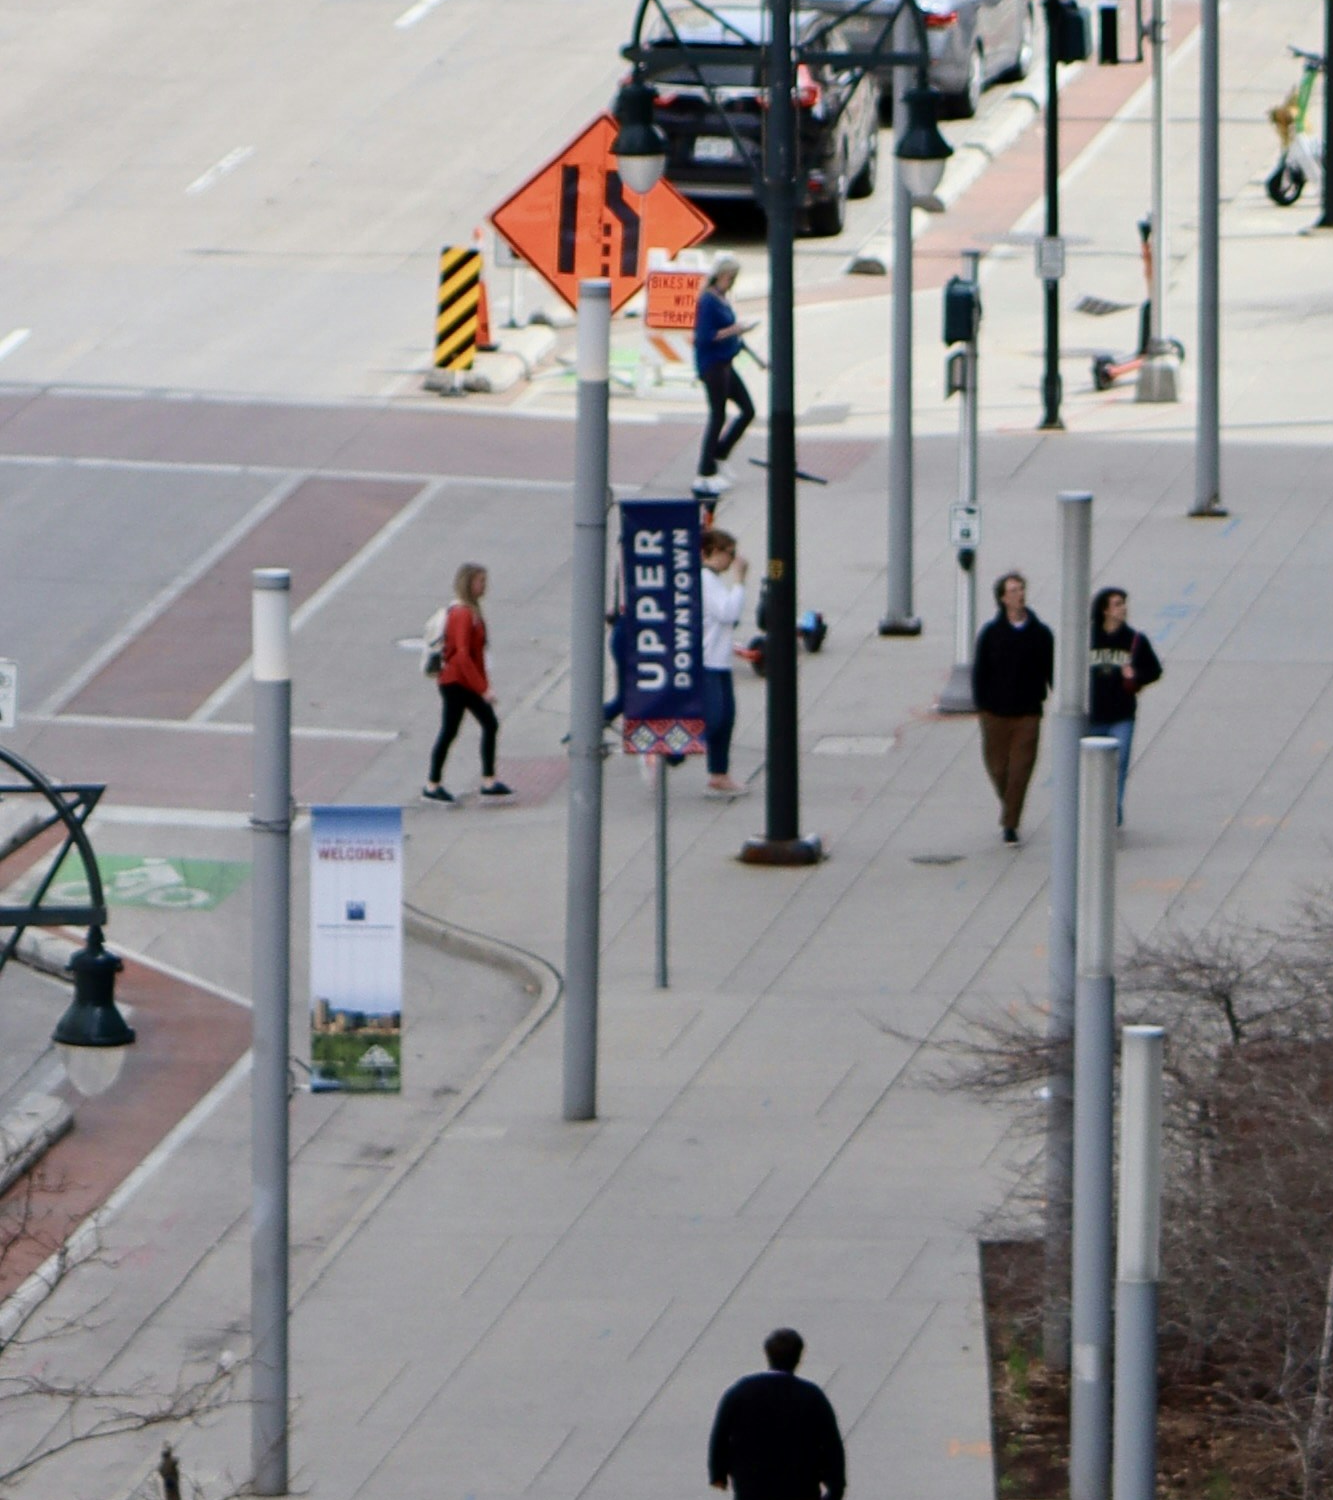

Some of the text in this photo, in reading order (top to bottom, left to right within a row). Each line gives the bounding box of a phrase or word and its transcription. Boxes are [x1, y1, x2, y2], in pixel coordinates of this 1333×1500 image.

[652, 276, 684, 289] BIKES
[634, 530, 667, 690] UPPER
[673, 529, 692, 688] DOWNTOWN
[318, 847, 395, 861] WELCOMES
